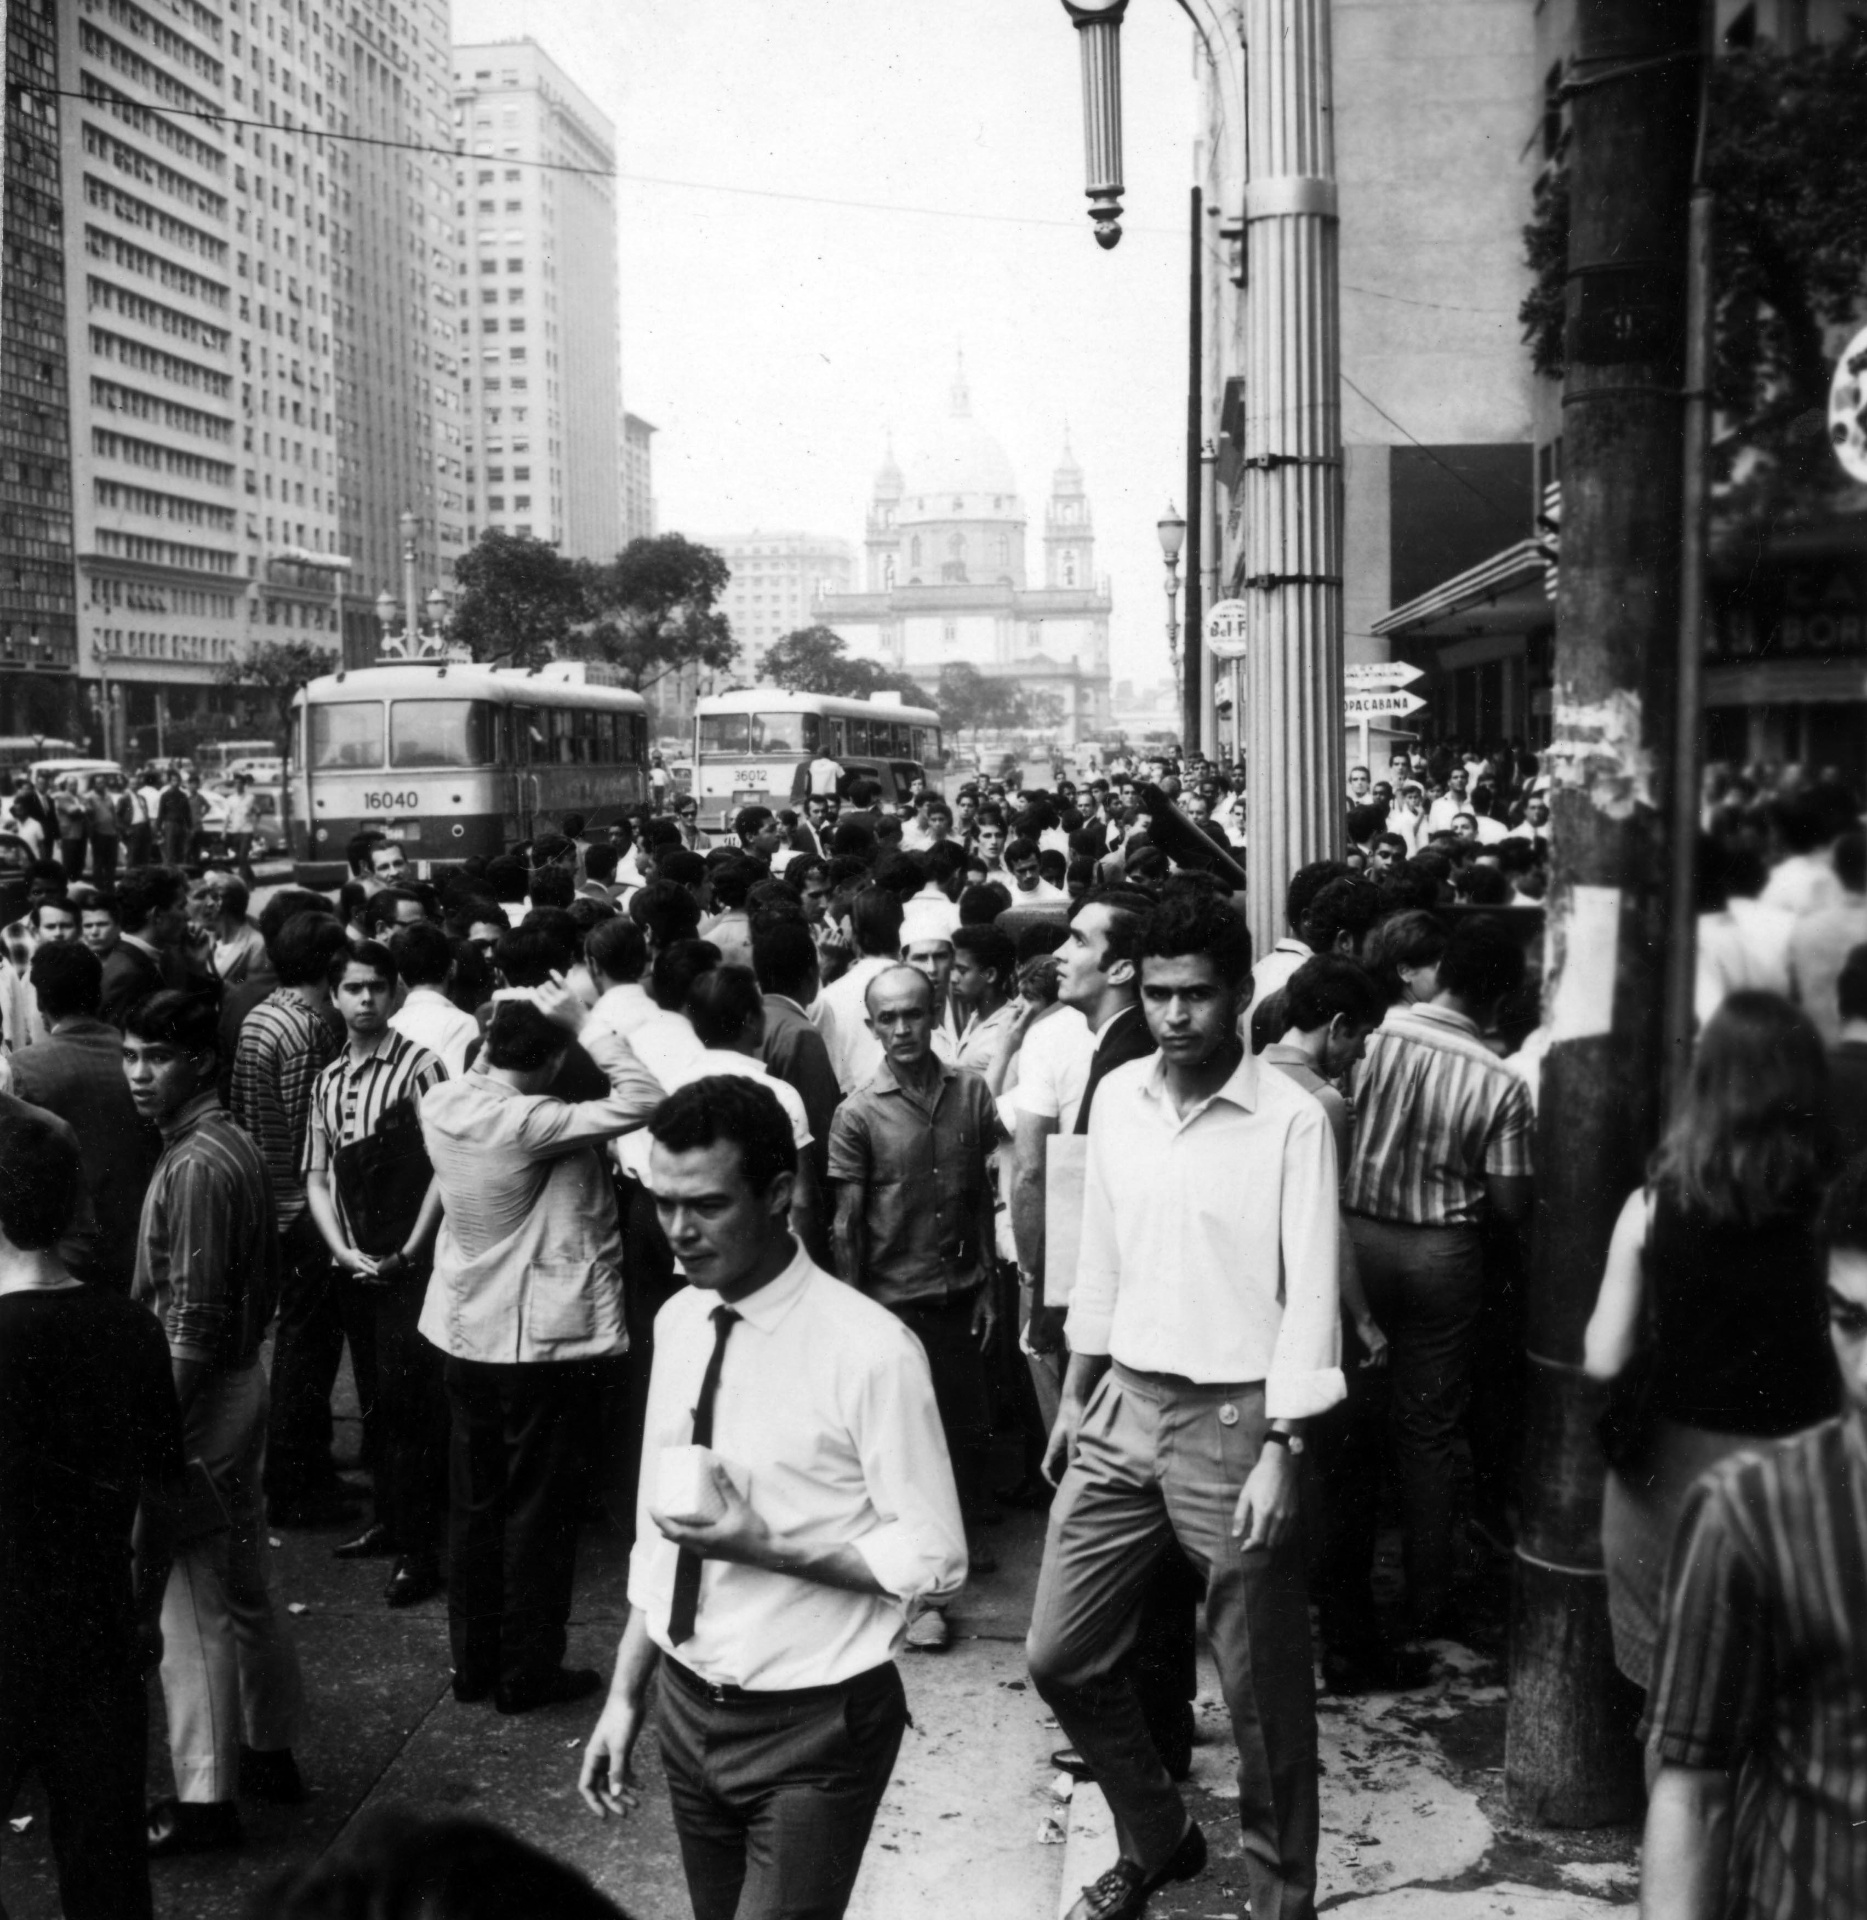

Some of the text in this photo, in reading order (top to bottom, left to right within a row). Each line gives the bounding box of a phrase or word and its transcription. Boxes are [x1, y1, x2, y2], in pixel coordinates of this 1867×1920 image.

[1344, 698, 1408, 712] OPACABANA
[734, 770, 768, 782] 36012
[364, 791, 418, 809] 16040
